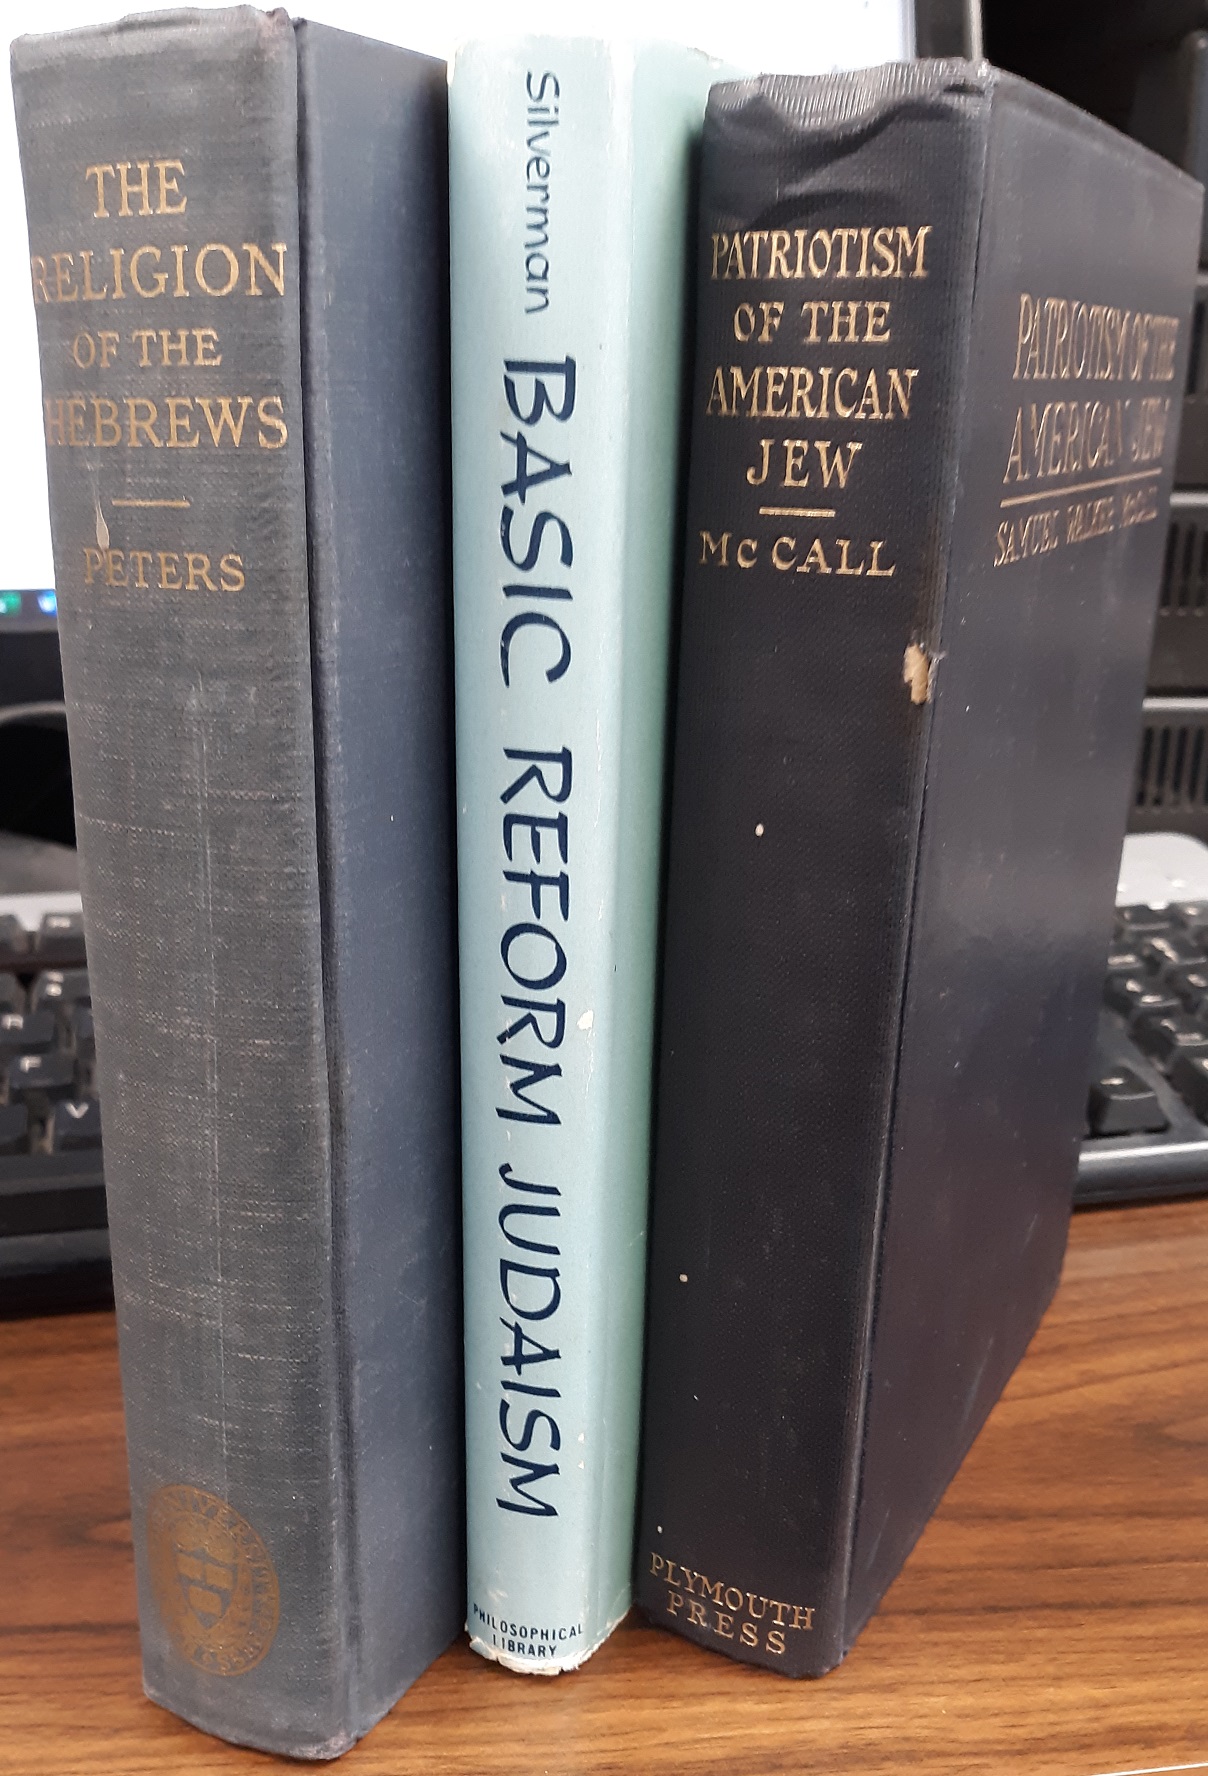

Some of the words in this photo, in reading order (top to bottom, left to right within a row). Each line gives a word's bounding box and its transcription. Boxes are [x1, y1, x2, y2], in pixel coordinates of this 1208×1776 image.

[85, 159, 188, 219] THE
[524, 69, 560, 314] Silverman
[32, 242, 288, 304] RELIGION
[711, 225, 933, 280] PATRIOTISM
[72, 331, 120, 369] OF
[131, 328, 223, 367] THE
[733, 302, 785, 342] OF
[801, 301, 891, 343] THE
[705, 366, 920, 419] AMERICAN
[45, 396, 290, 449] HEBREWS
[746, 439, 863, 489] JEW
[500, 356, 577, 688] BASIC
[84, 549, 246, 593] PETERS
[771, 537, 897, 577] CALL
[496, 746, 573, 1126] REFORM
[496, 1162, 562, 1517] JUDAISM
[650, 1552, 816, 1631] PLYMOUTH
[473, 1602, 584, 1642] PHILOSOPHICAL
[493, 1634, 558, 1659] LIBRARY
[666, 1590, 787, 1655] PRESS
